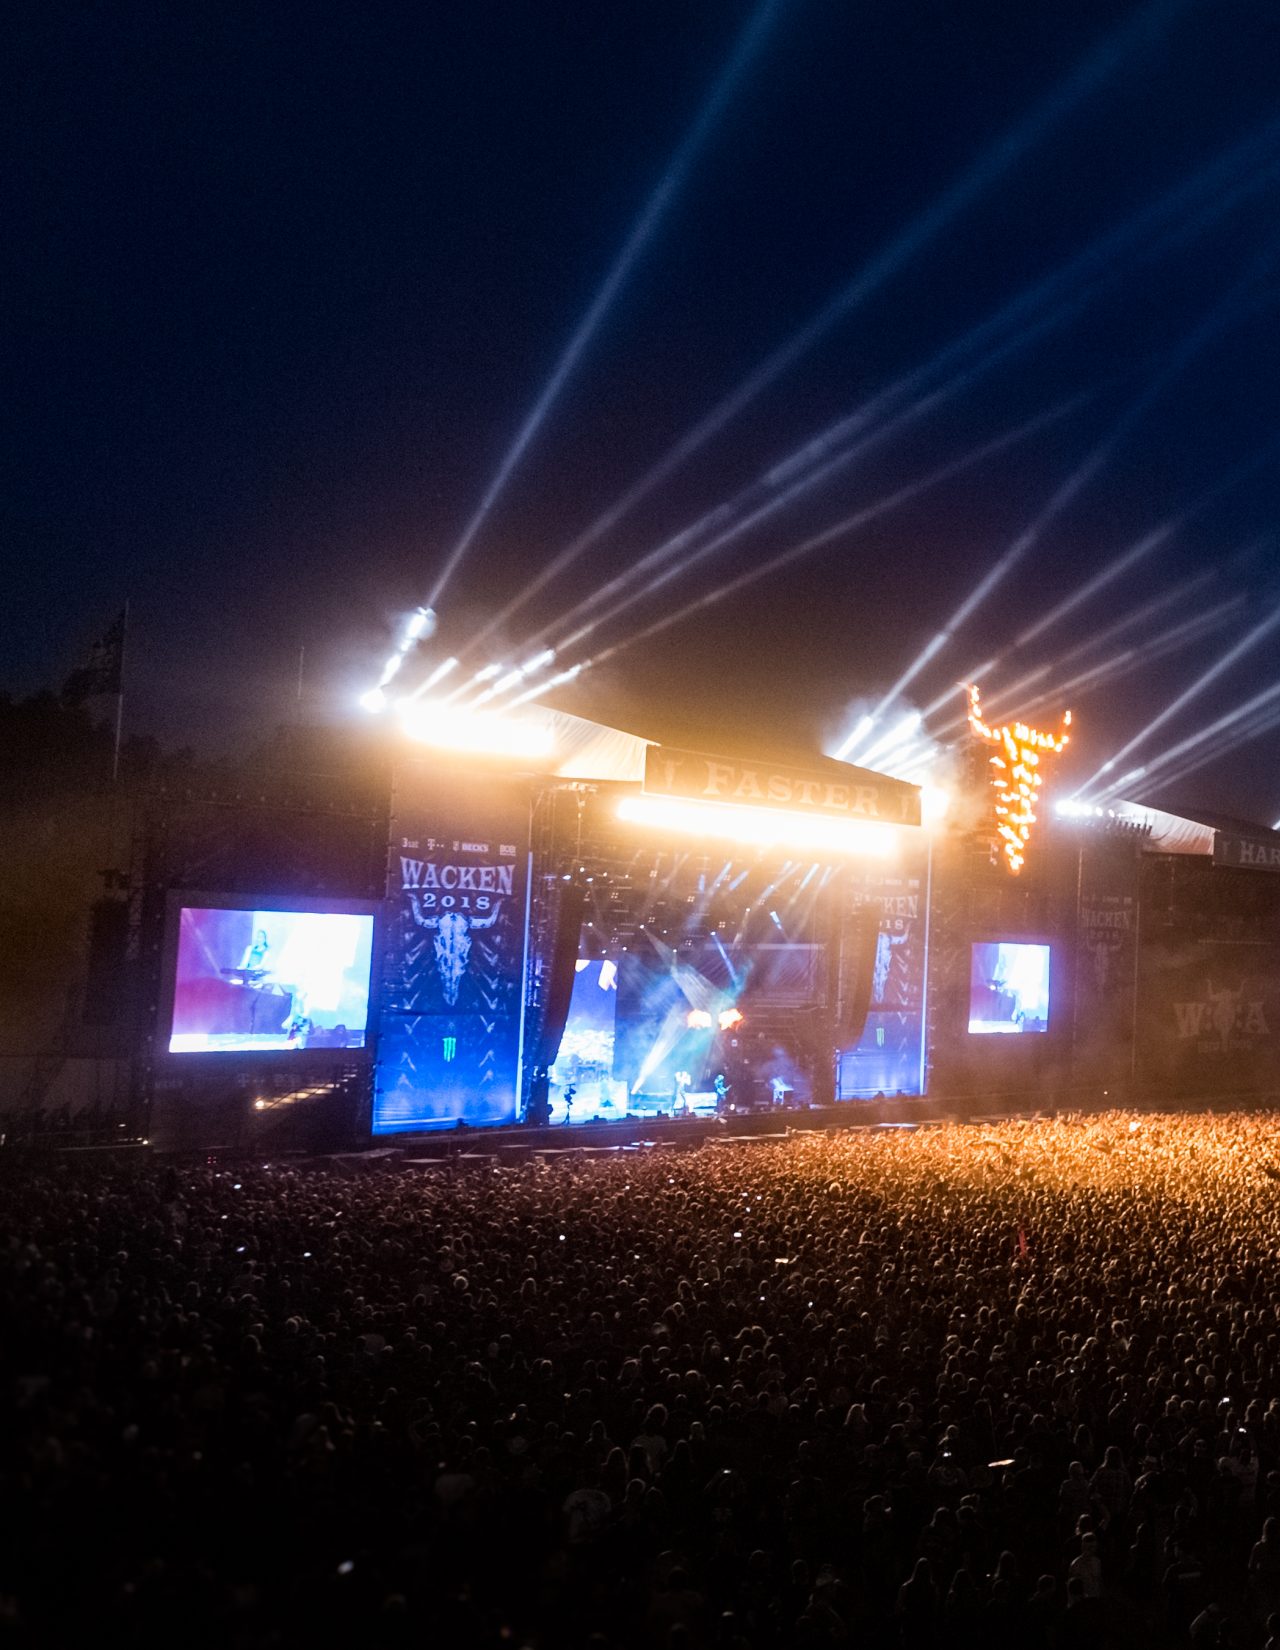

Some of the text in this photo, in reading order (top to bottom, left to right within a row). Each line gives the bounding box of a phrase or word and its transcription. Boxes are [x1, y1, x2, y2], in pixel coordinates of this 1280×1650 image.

[703, 761, 880, 817] FASTER
[400, 856, 516, 895] WACKEN
[423, 893, 490, 910] 2018
